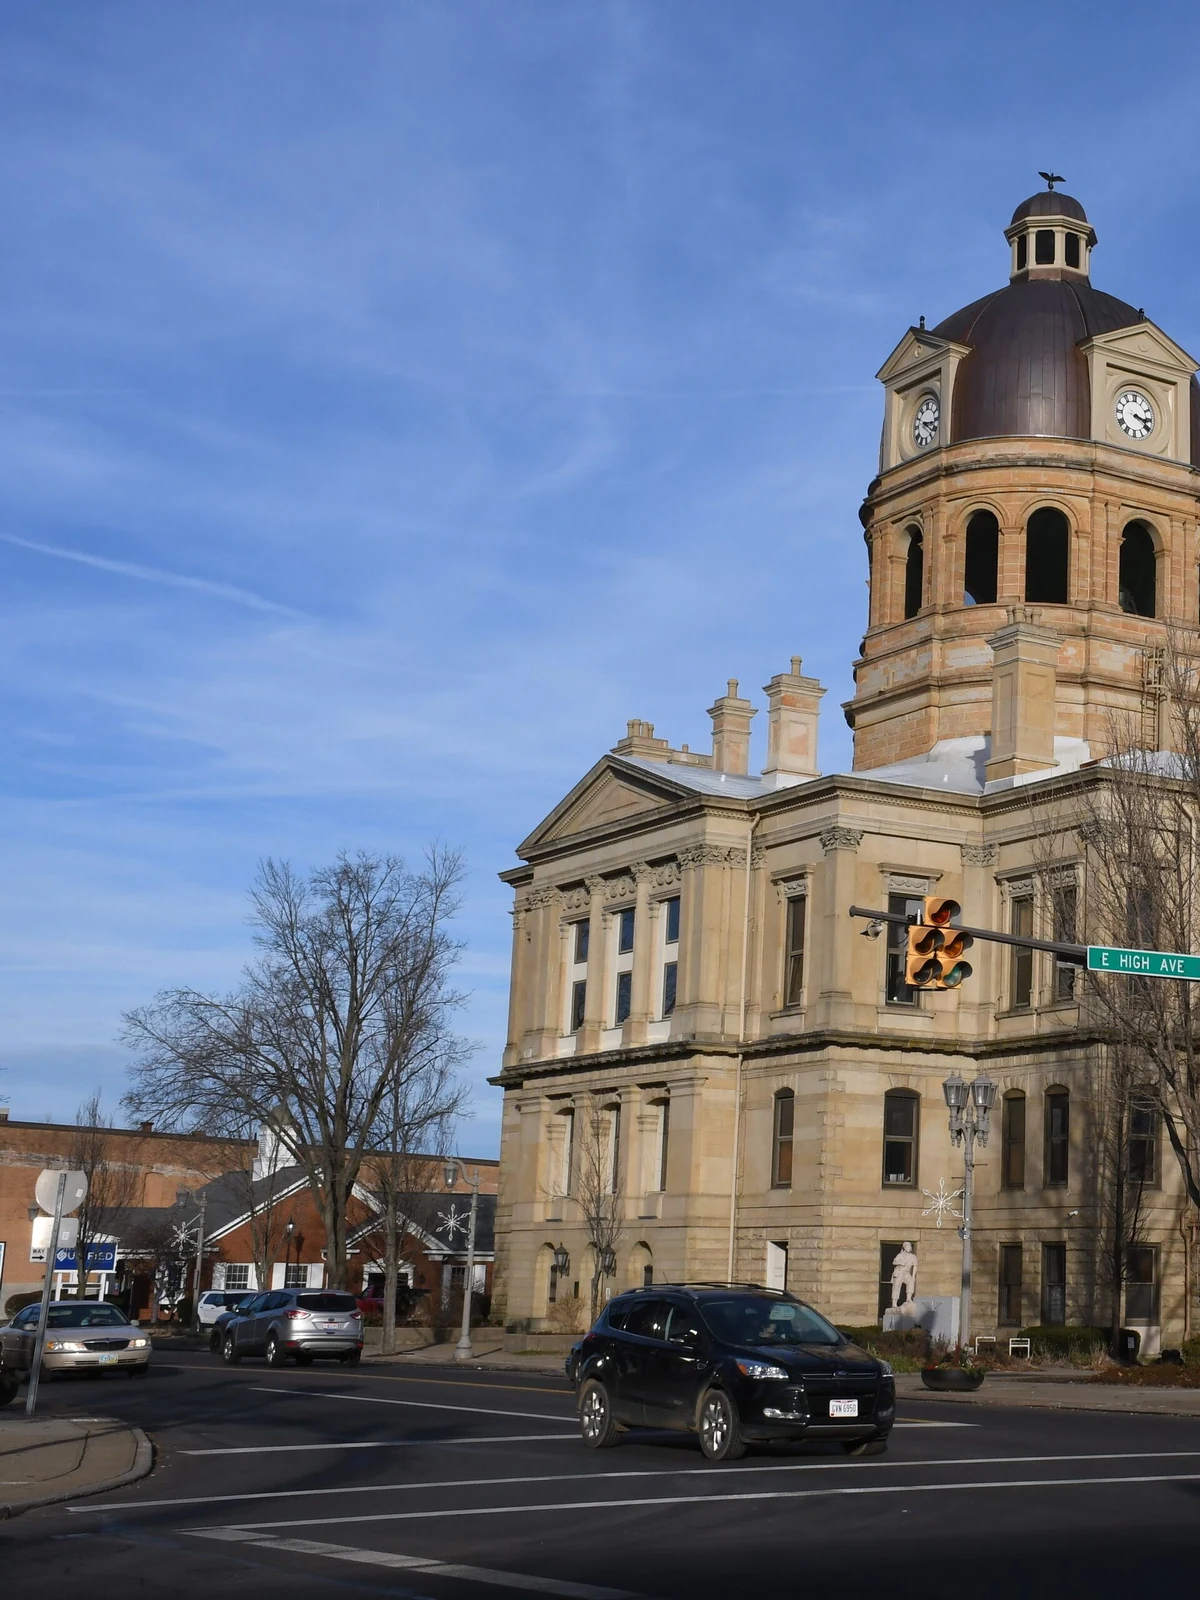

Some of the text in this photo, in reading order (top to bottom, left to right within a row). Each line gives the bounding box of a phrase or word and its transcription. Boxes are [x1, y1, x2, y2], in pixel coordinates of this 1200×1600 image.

[1102, 952, 1184, 973] E HIGH AVE
